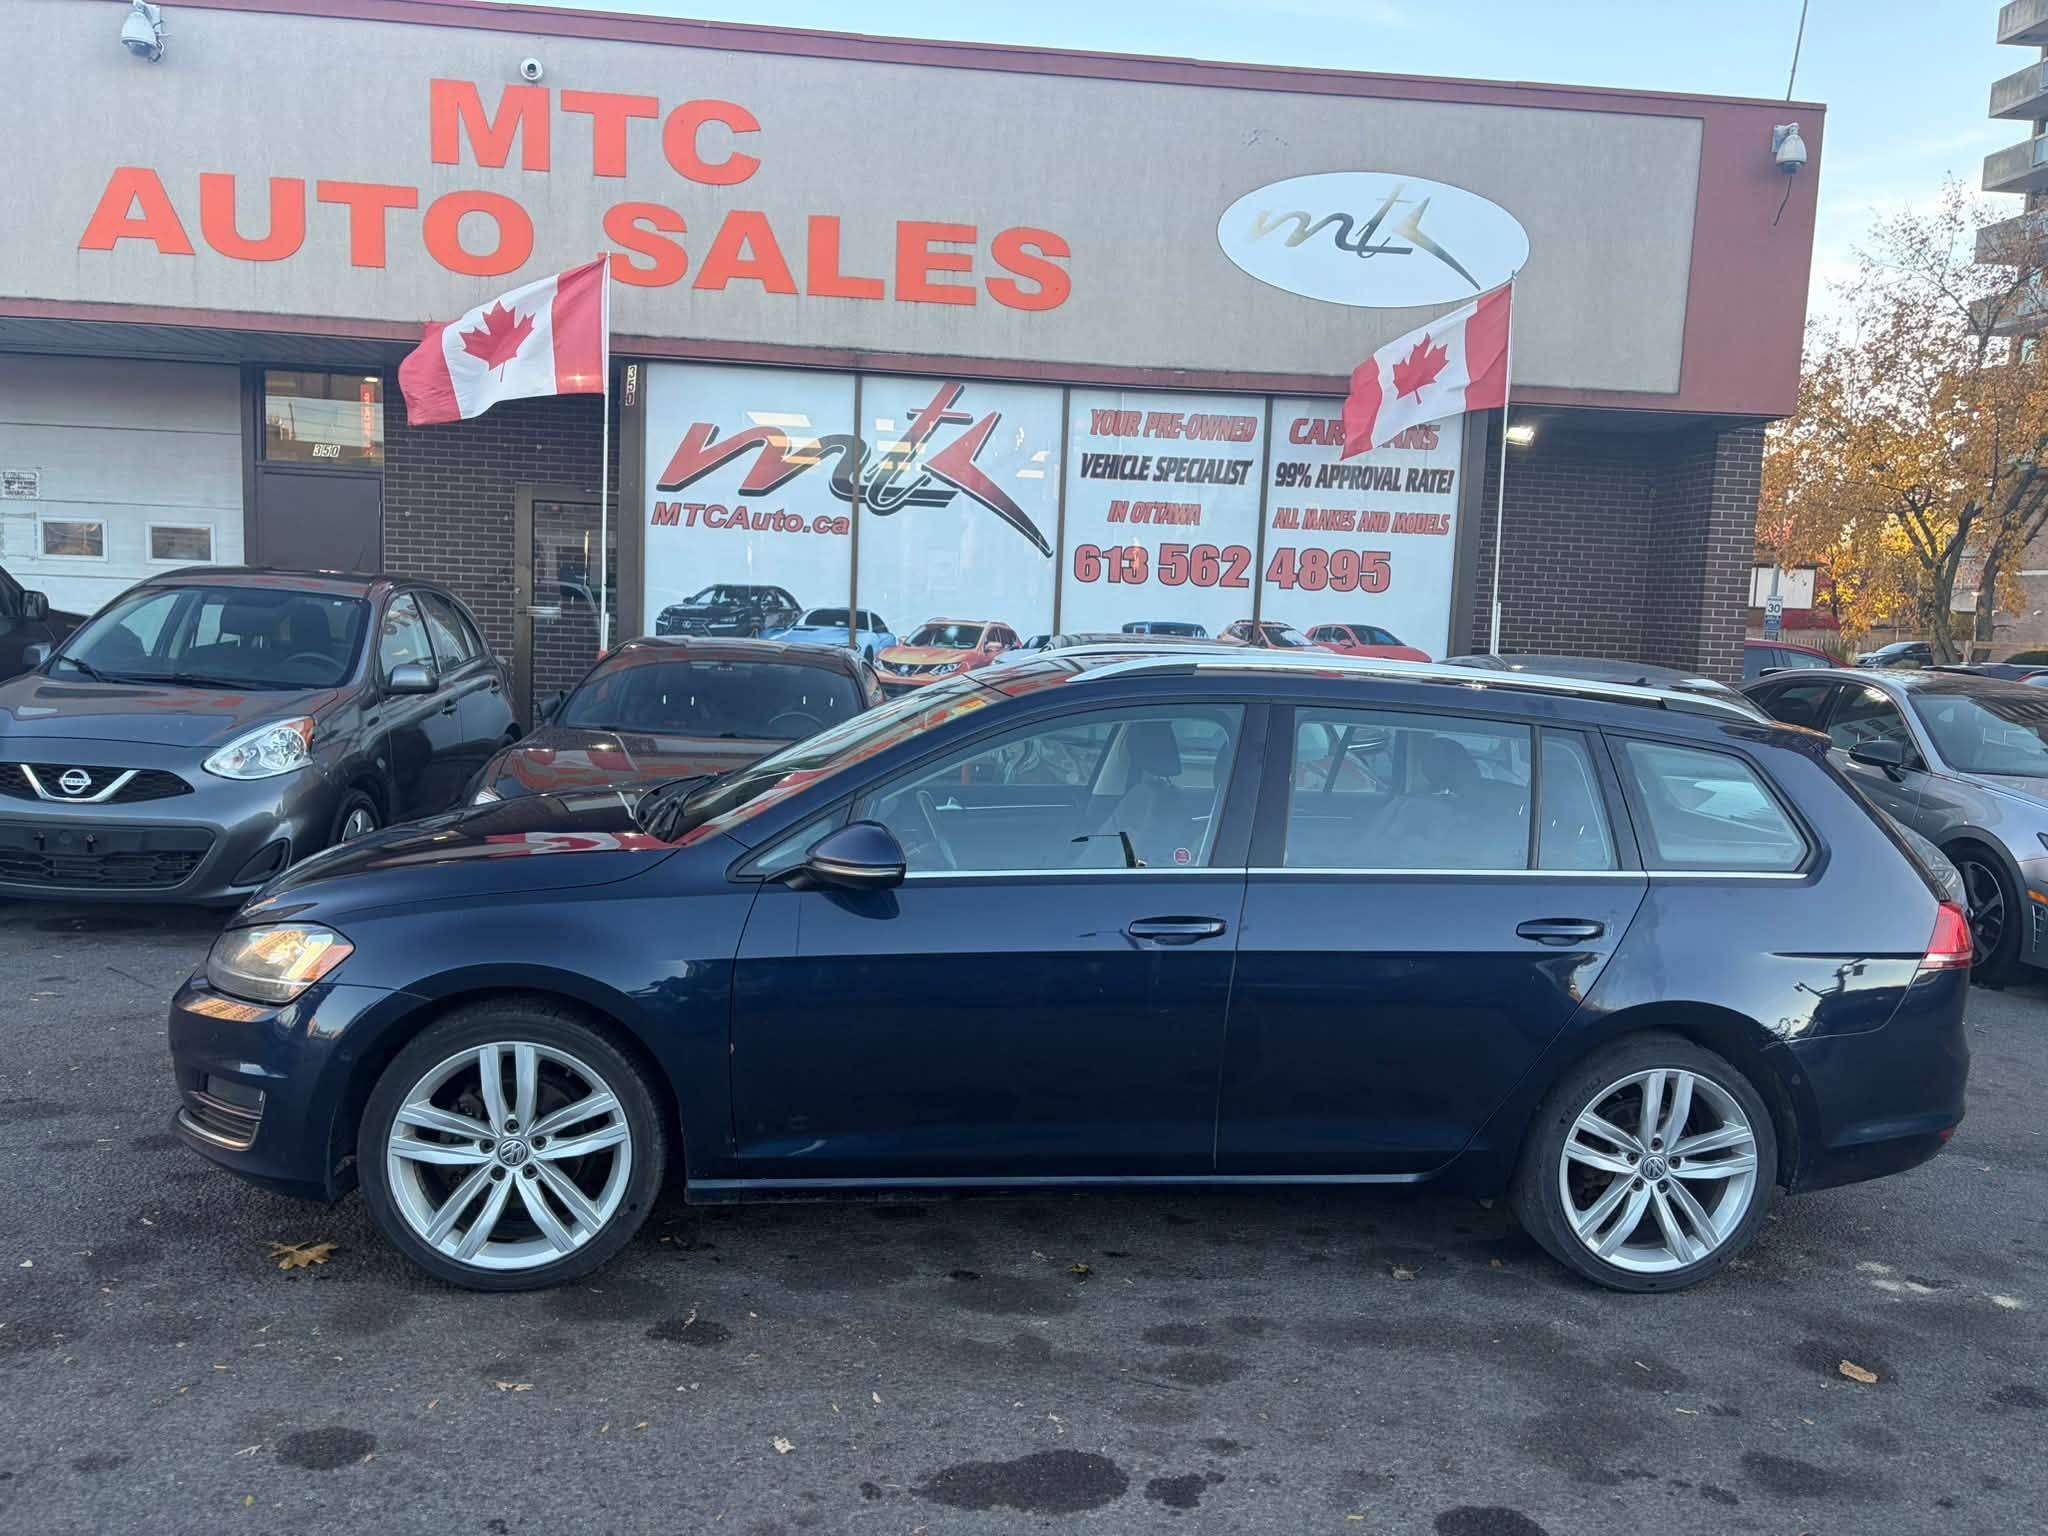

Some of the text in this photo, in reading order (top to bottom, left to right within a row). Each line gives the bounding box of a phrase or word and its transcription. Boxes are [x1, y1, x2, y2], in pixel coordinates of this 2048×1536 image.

[430, 78, 761, 185] MTC
[79, 167, 1072, 311] AUTO SALES
[627, 366, 637, 405] 350
[1090, 409, 1258, 442] YOUR PRE-OWNED
[313, 444, 340, 457] 350
[1080, 453, 1253, 485] VEHICLE SPECIALIST
[1275, 462, 1455, 494] 99% APPROVAL RATE!
[651, 502, 850, 535] MTCAuto.ca
[1107, 500, 1201, 526] IN OTTAWA
[1273, 507, 1450, 535] ALL MAKES AND MODELS
[1074, 543, 1392, 593] 613 562 4895
[1767, 603, 1781, 613] 30
